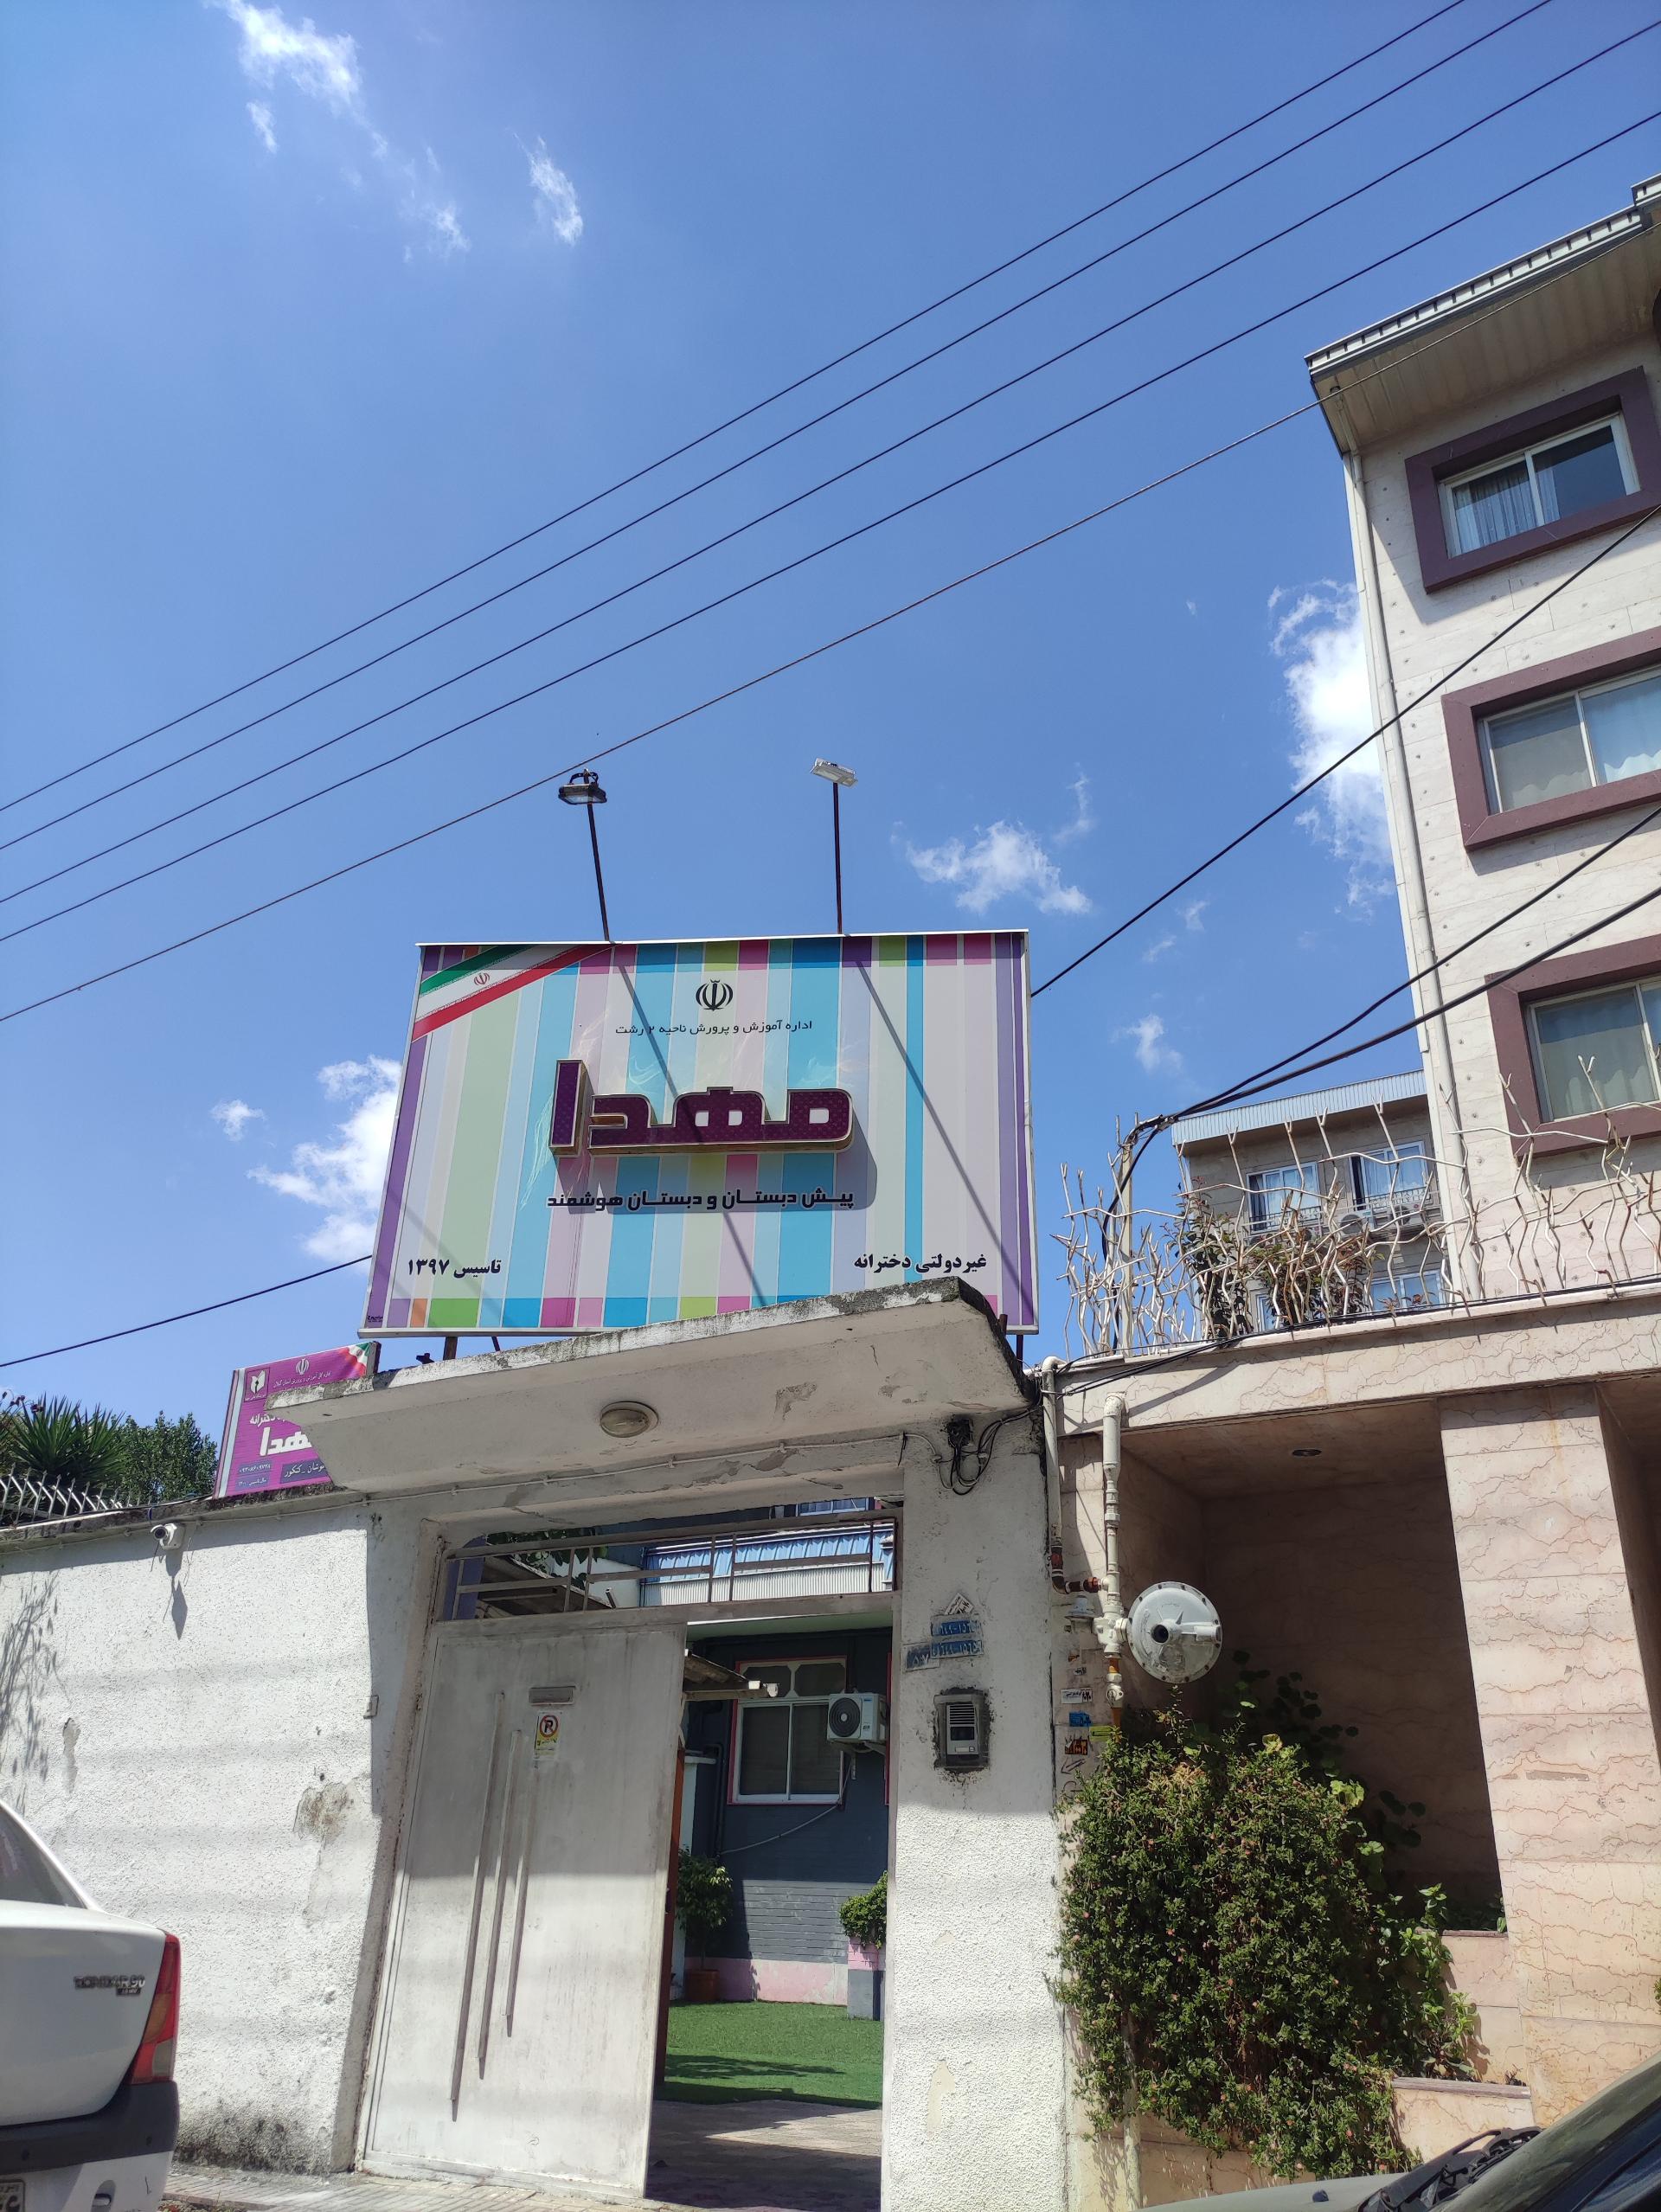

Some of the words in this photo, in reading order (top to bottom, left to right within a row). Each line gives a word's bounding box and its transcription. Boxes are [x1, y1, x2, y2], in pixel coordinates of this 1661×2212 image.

[615, 1025, 645, 1036] رشت
[648, 1025, 655, 1035] ۲
[658, 1023, 687, 1035] ناحیه
[689, 1024, 730, 1035] پرورش
[733, 1025, 739, 1034] و
[742, 1019, 783, 1035] آموزش
[786, 1020, 812, 1031] اداره
[548, 1059, 854, 1156] مهدا
[547, 1191, 624, 1212] هوشمند
[627, 1190, 702, 1211] دبستان
[707, 1196, 717, 1210] و
[722, 1189, 798, 1210] دبستان
[801, 1187, 854, 1209] پیش
[407, 1258, 450, 1276] ۱۳۹۷
[452, 1259, 502, 1279] تاسیس
[854, 1253, 911, 1273] دخترانه
[260, 1427, 312, 1457] هدا
